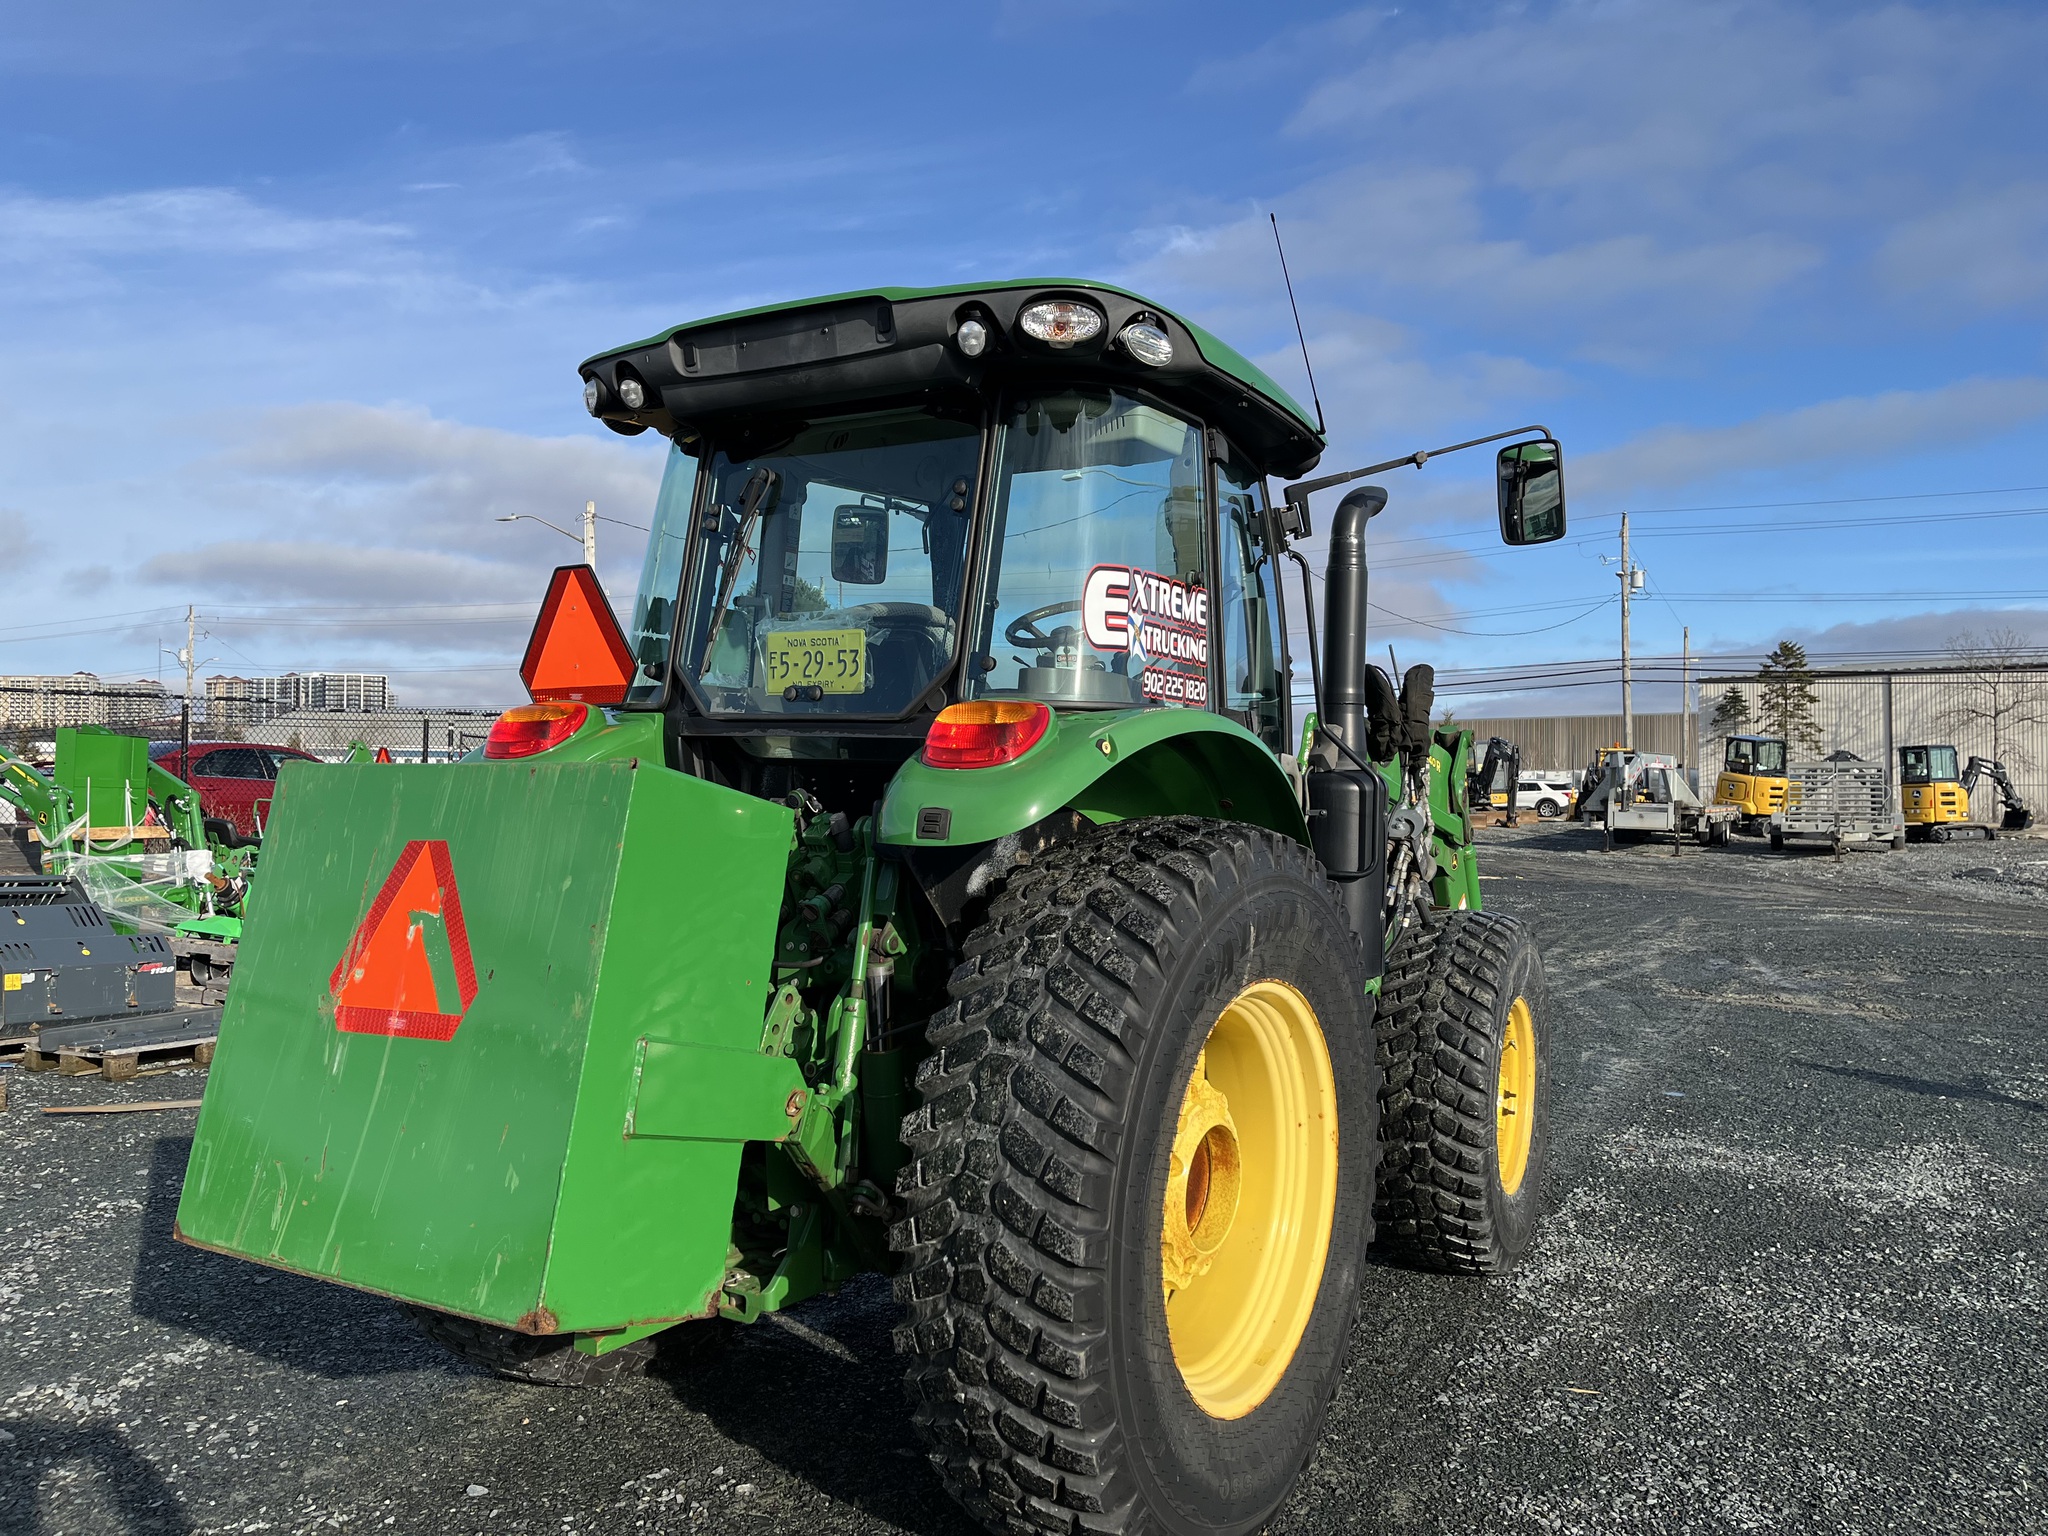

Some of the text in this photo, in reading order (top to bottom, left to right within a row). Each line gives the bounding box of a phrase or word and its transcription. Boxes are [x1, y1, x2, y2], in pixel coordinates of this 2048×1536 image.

[1083, 566, 1207, 649] EXTREME
[787, 637, 840, 648] NOVA SCOTIA
[1143, 623, 1207, 665] TRUCKING
[779, 649, 860, 680] 5-29-53
[1143, 670, 1207, 703] 902 225 1820
[150, 965, 174, 975] 1150
